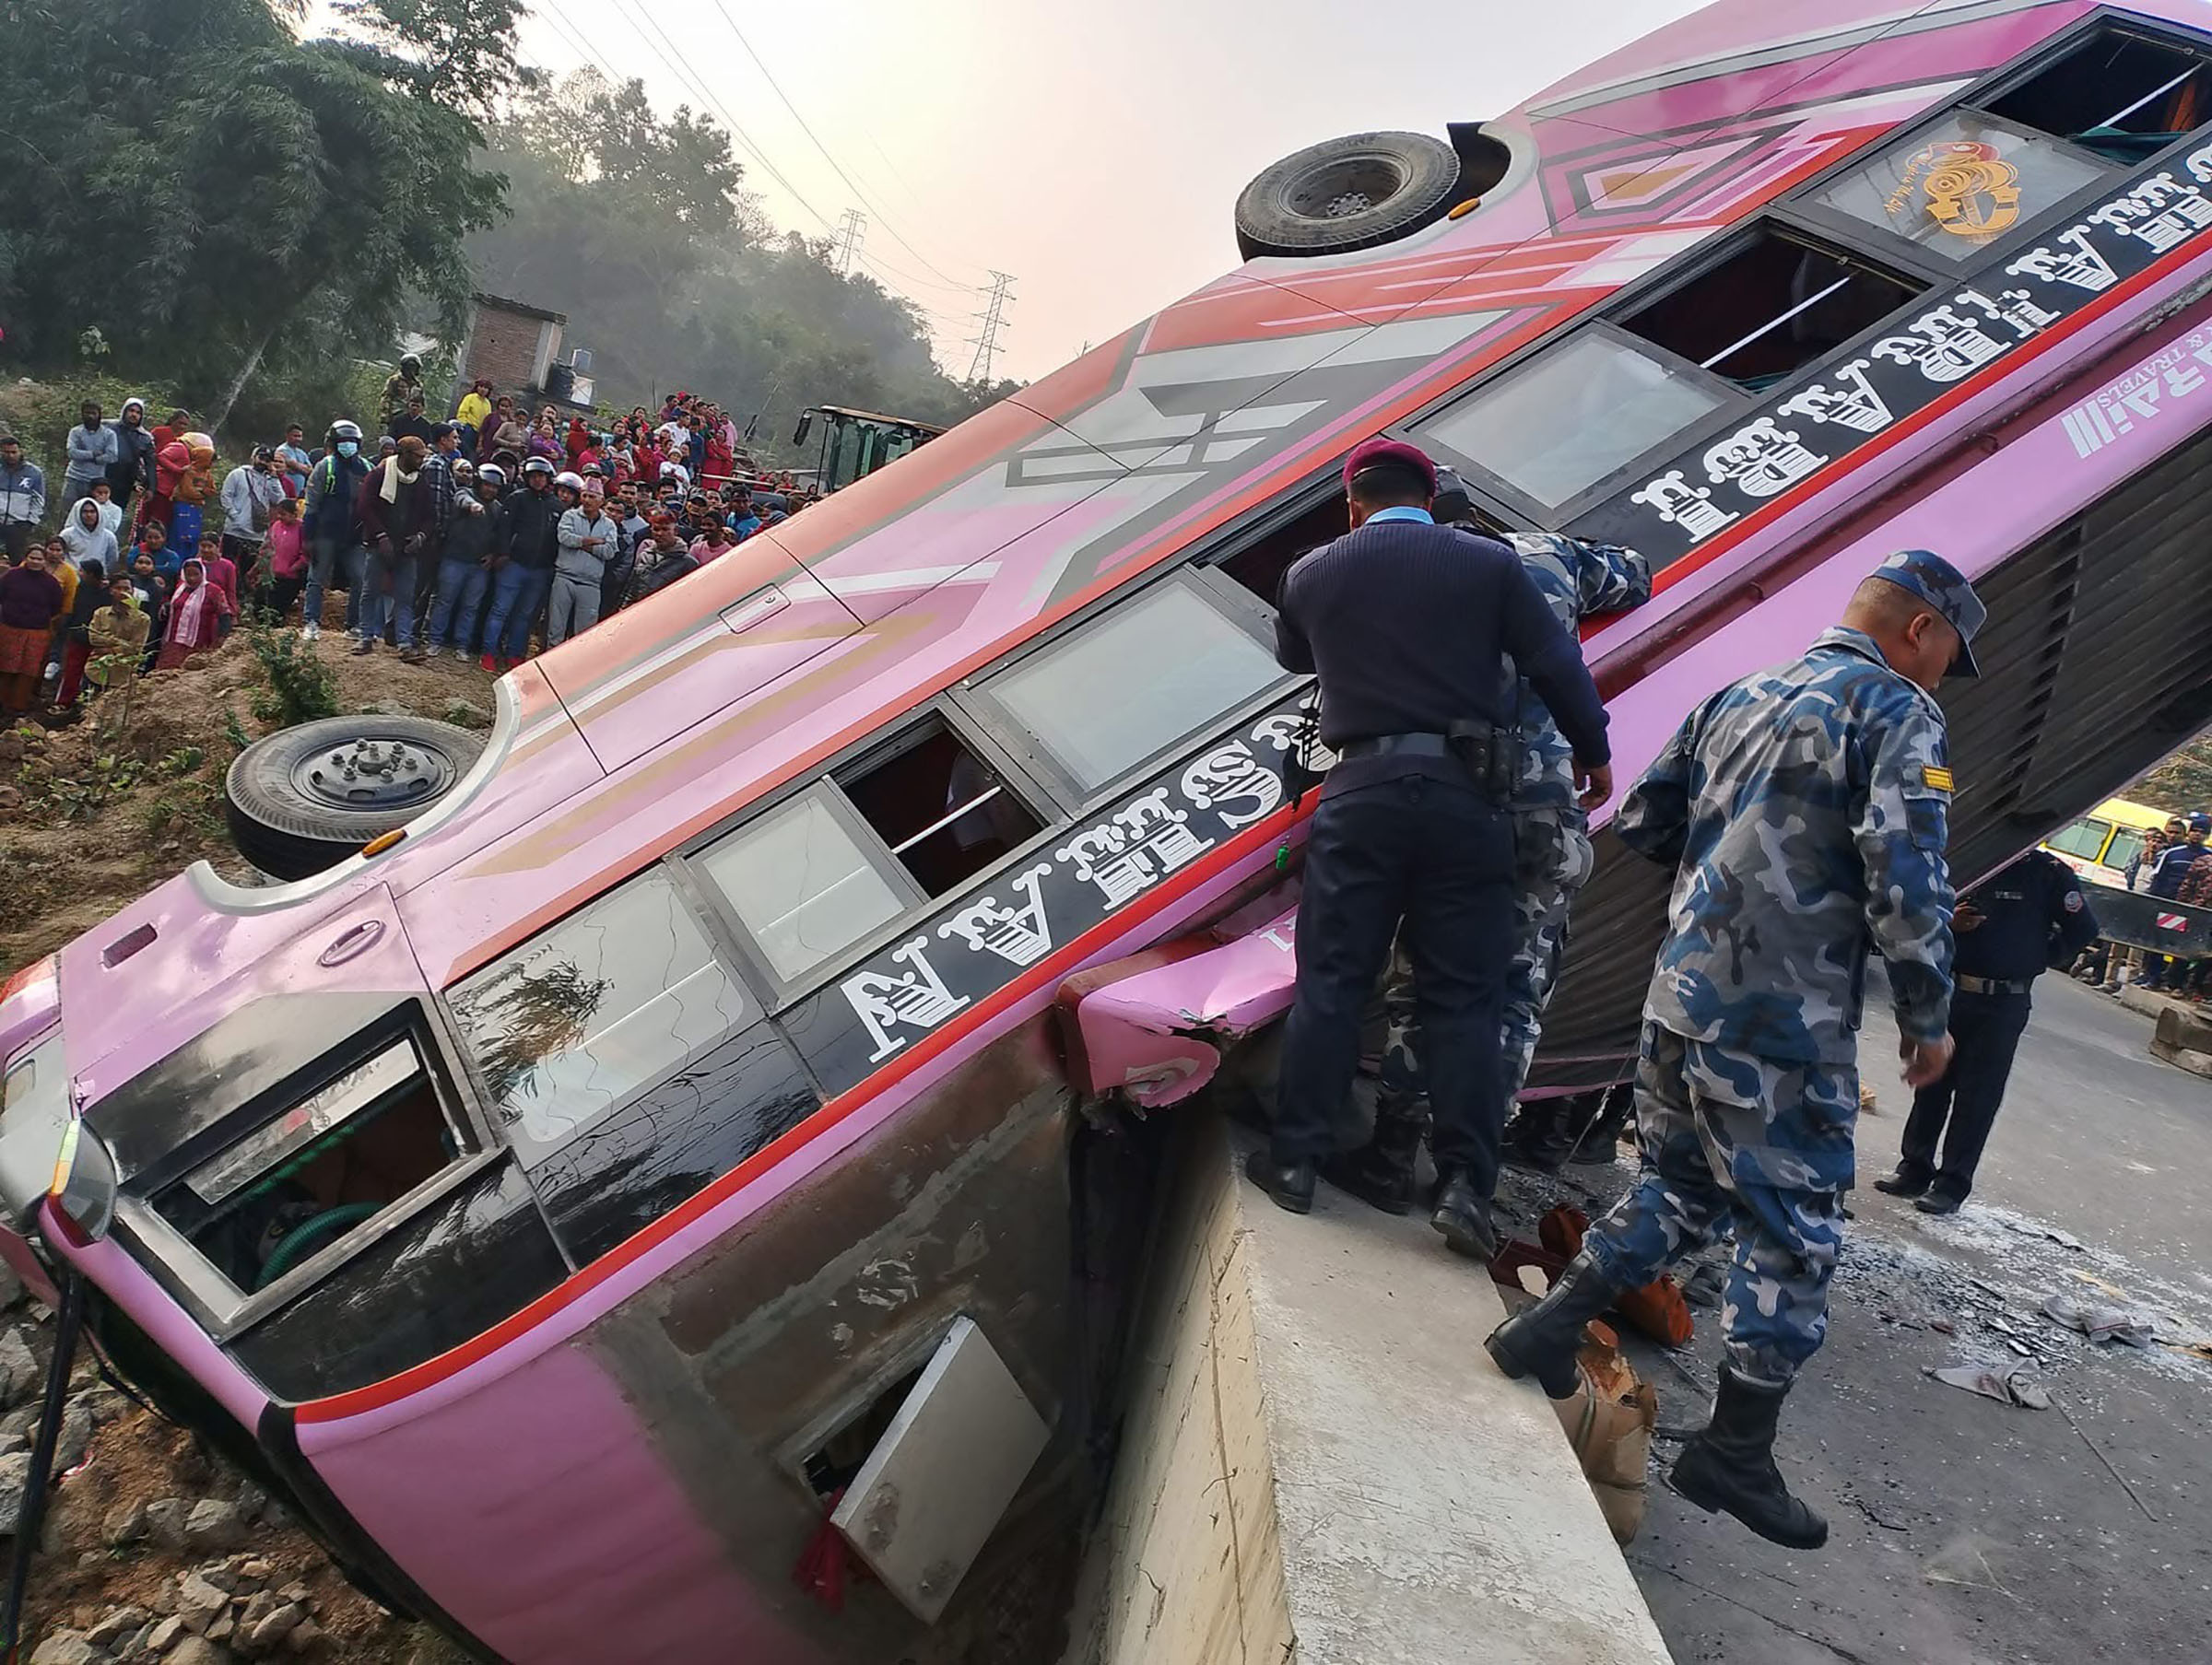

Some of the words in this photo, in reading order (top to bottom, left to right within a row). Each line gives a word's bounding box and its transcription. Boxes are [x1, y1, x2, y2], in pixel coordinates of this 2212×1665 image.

[1630, 141, 2212, 544] HAIRABI
[2097, 347, 2187, 408] TRAVELS
[840, 686, 1344, 1063] RSHAN
